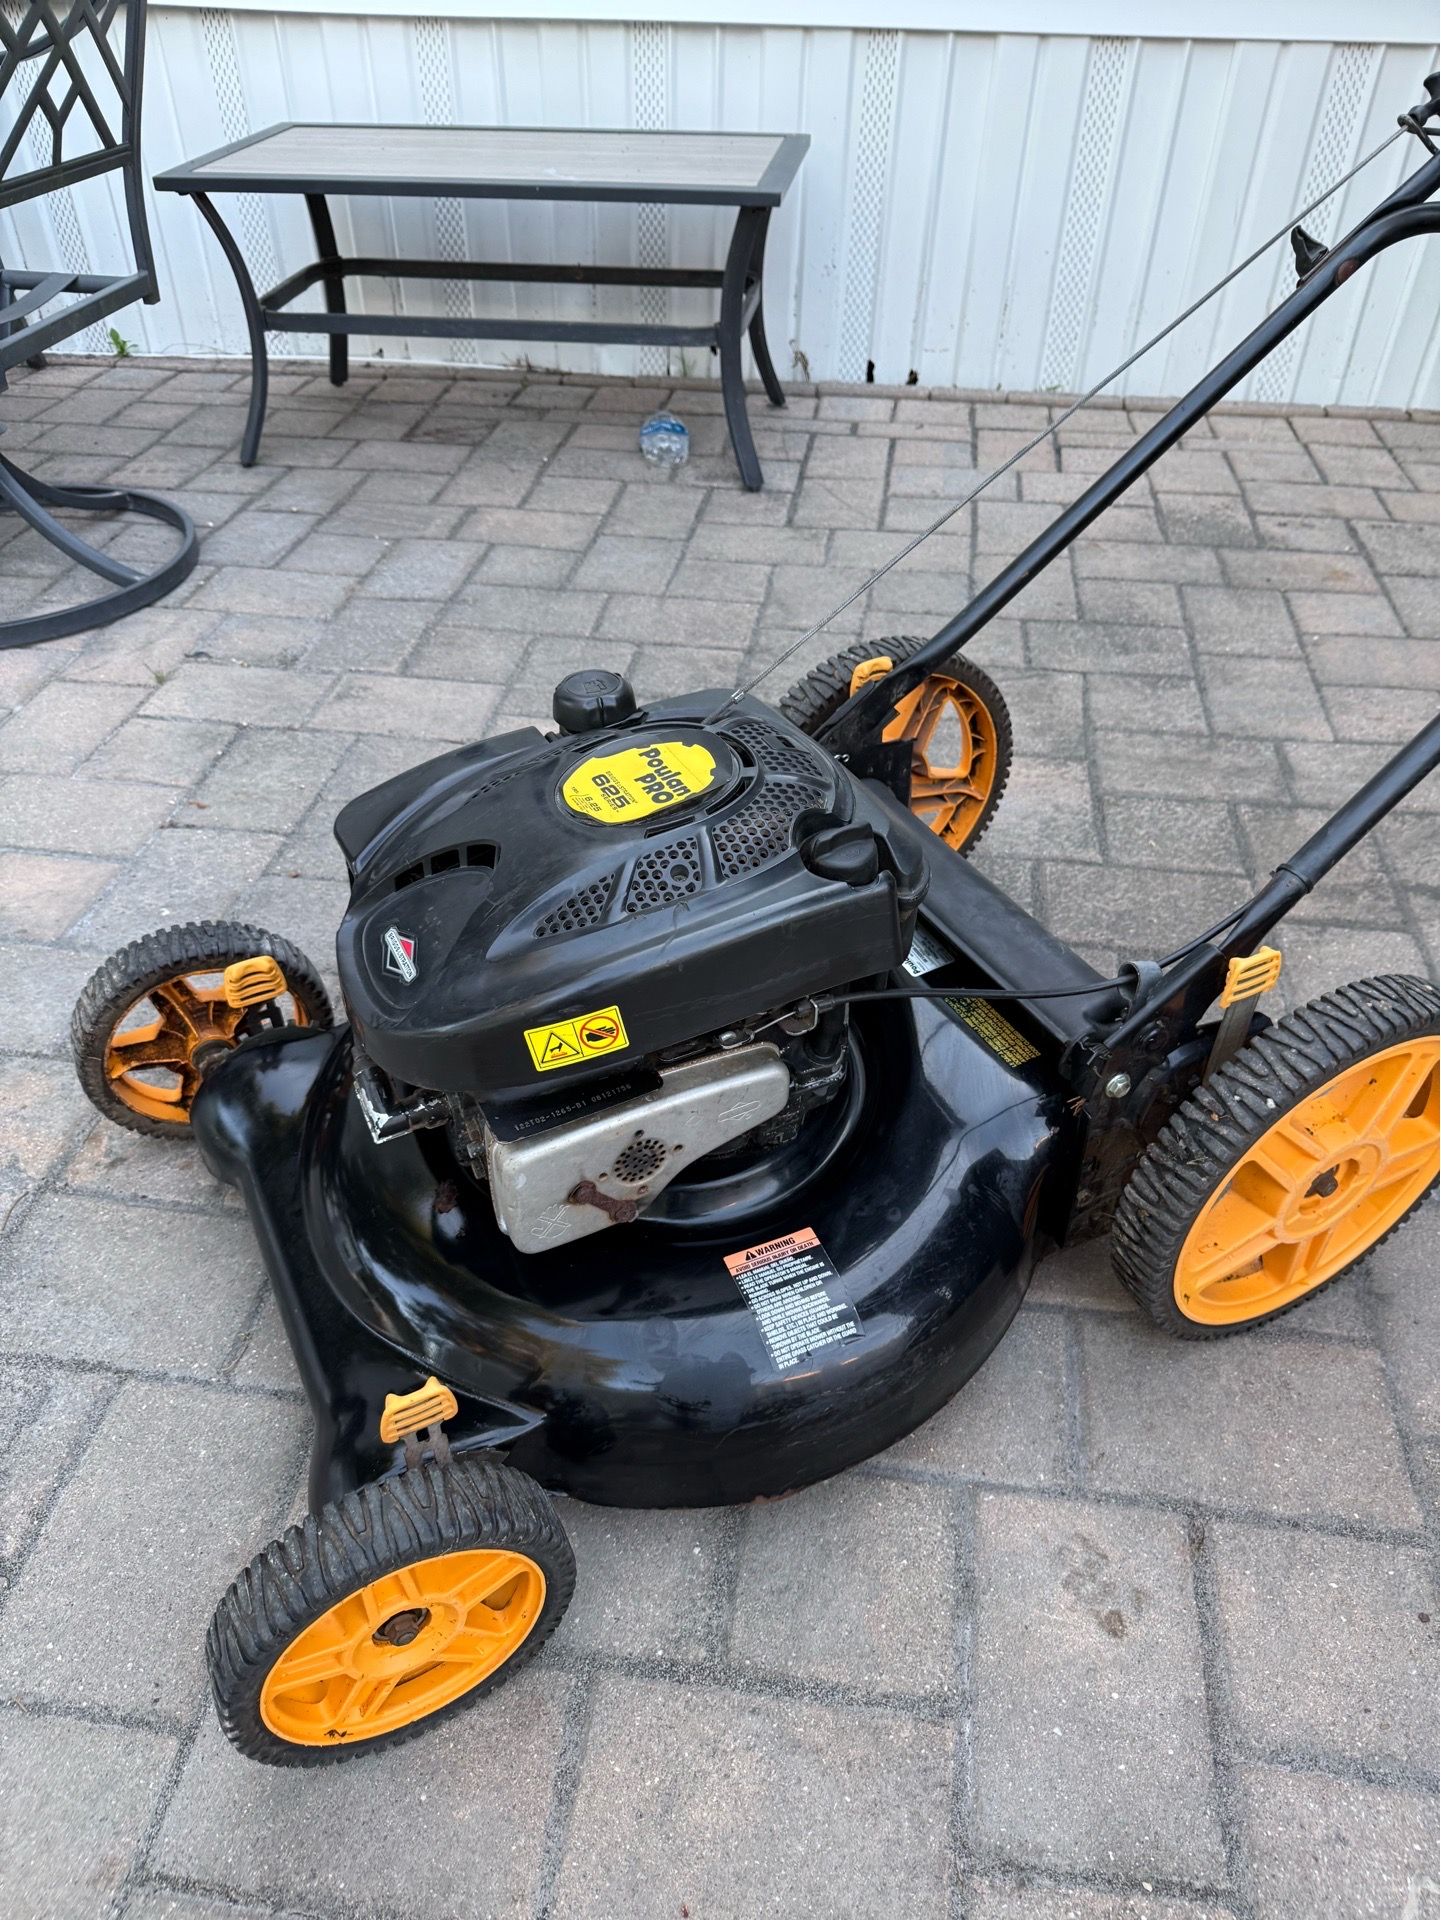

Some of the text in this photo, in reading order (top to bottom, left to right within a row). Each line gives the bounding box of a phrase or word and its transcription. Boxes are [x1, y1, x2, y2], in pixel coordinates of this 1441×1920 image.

[639, 748, 691, 797] Poulan
[591, 774, 631, 809] 625
[634, 773, 675, 804] PRO
[584, 796, 601, 812] 6.25
[906, 959, 921, 975] Poul
[755, 1237, 796, 1257] WARNING
